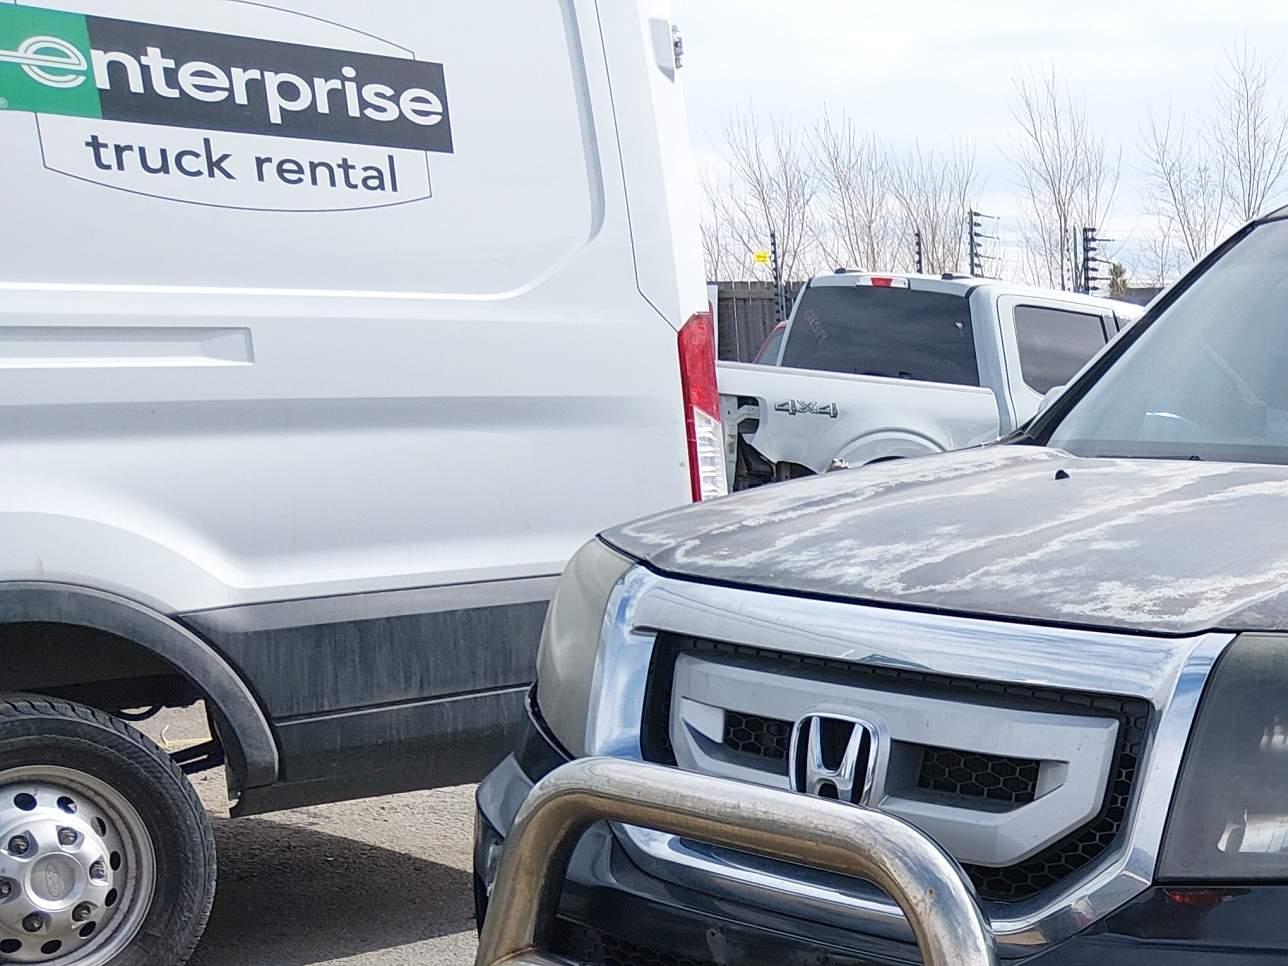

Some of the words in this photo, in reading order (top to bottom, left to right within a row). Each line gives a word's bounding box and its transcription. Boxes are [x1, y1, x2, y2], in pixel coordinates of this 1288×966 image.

[0, 35, 444, 126] enterprise
[84, 133, 237, 181] truck
[254, 152, 399, 193] rental
